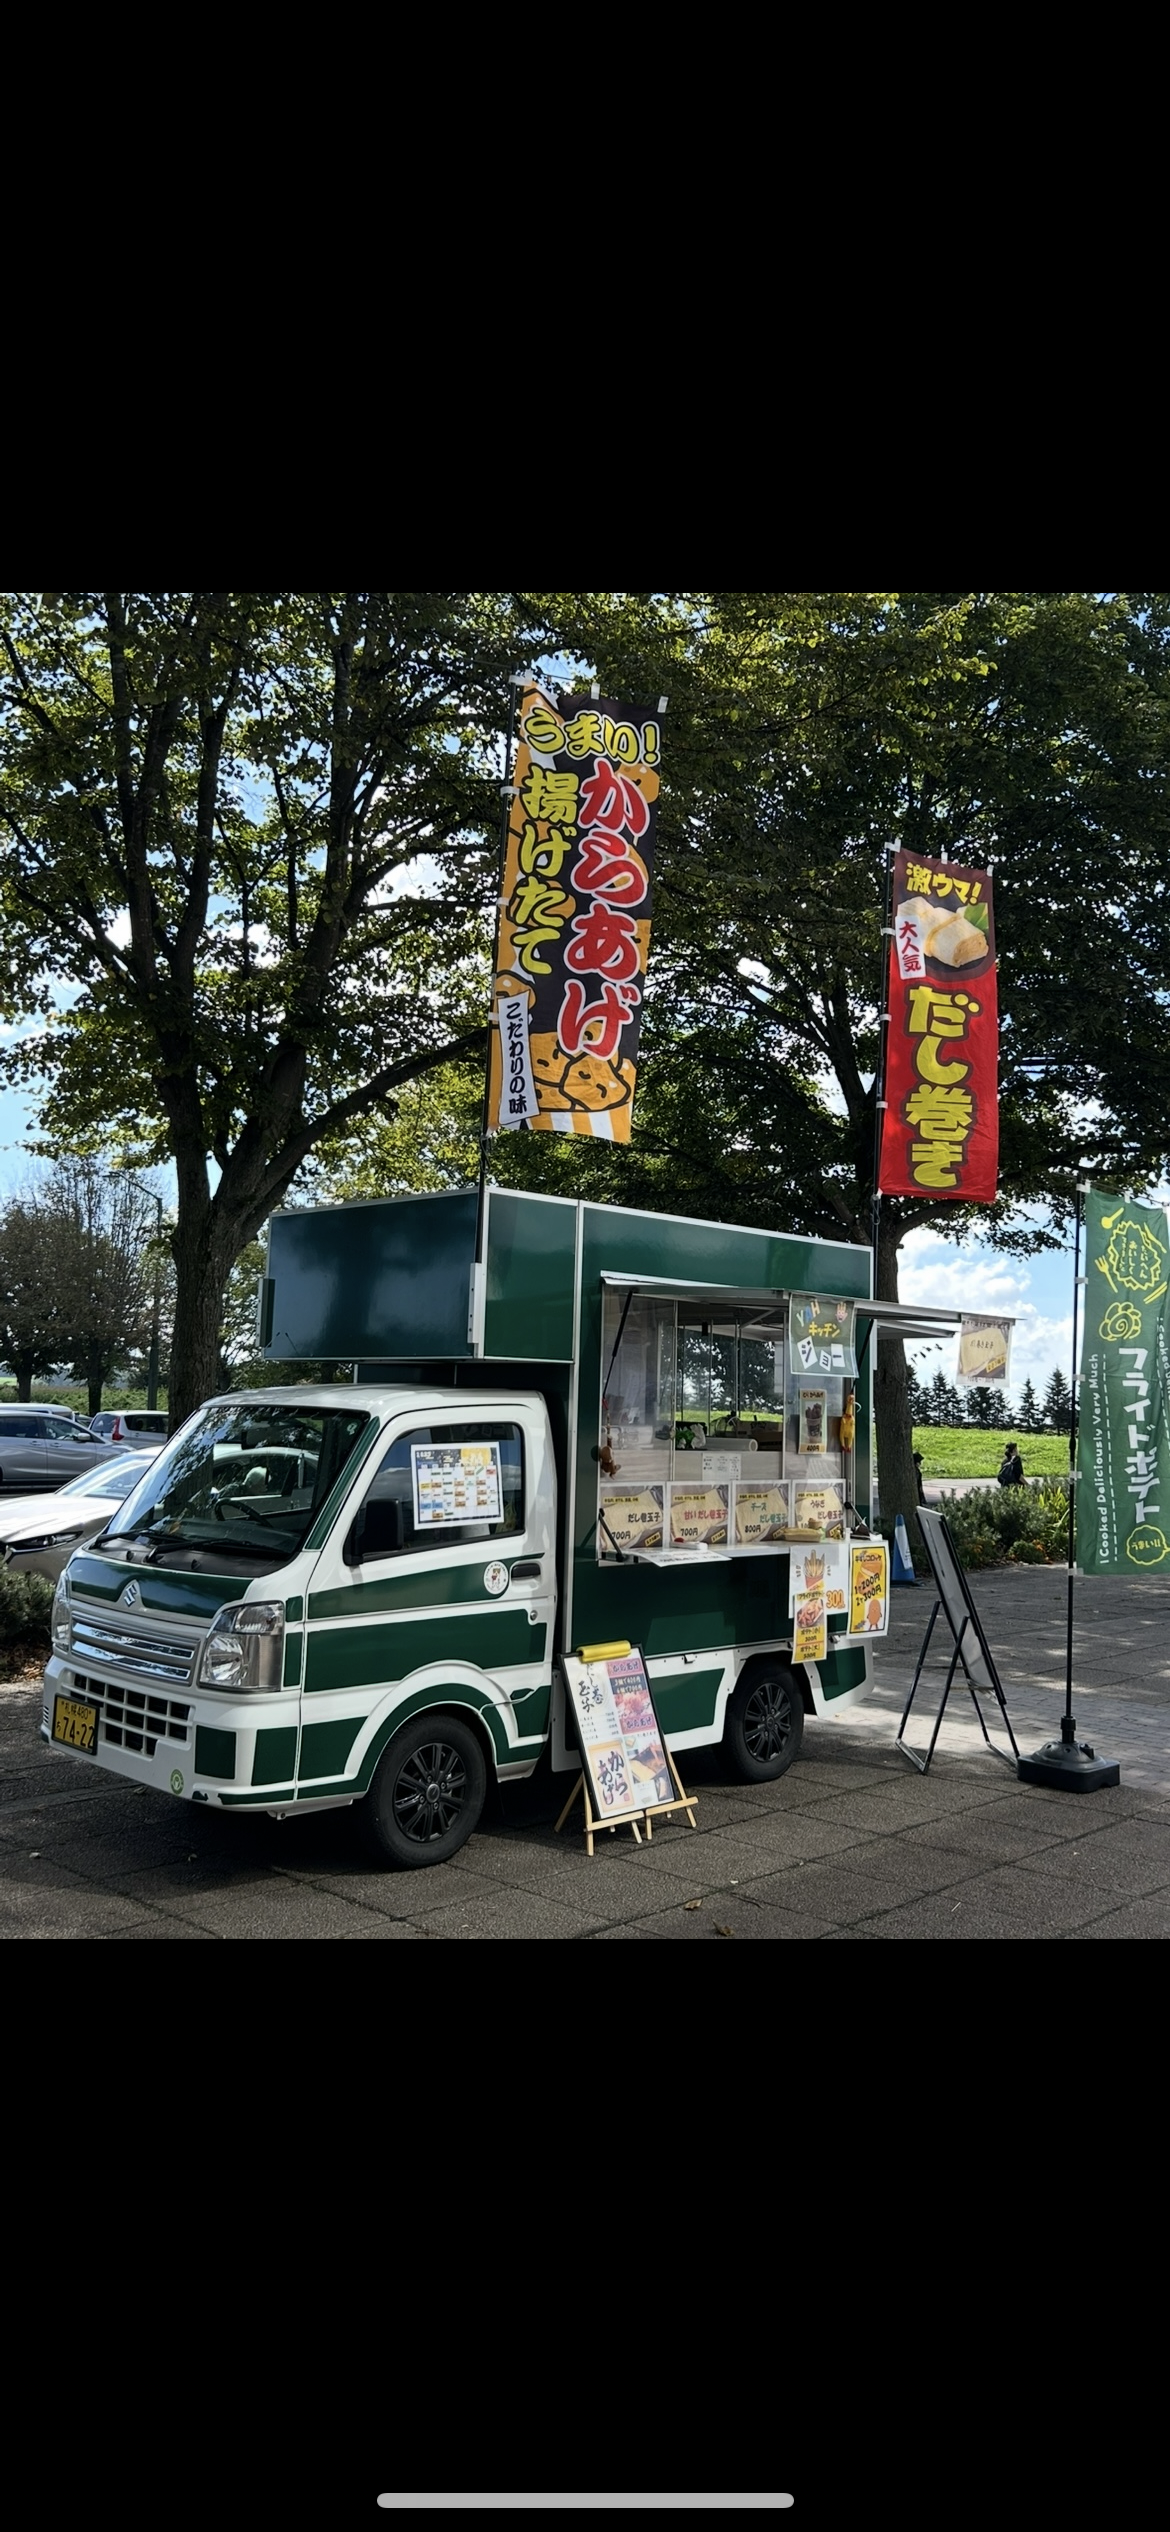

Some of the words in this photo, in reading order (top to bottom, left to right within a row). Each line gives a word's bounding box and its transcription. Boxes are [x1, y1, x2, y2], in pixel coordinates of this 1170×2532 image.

[511, 764, 578, 975] 揚げたて
[906, 862, 982, 904] 激ウマ!
[560, 760, 648, 1058] からあげ
[899, 921, 921, 972] 大人気
[506, 1002, 527, 1114] こだわりの味
[905, 985, 980, 1188] だし巻き
[796, 1299, 821, 1327] YAH
[808, 1321, 841, 1338] キッチン
[1088, 1353, 1099, 1388] Much
[1092, 1391, 1103, 1426] Very
[1118, 1347, 1160, 1524] フライドポテト
[1093, 1428, 1106, 1503] Deliciously
[680, 1527, 698, 1536] 700円
[1098, 1507, 1110, 1558] Cooked
[63, 1716, 95, 1748] 74-22
